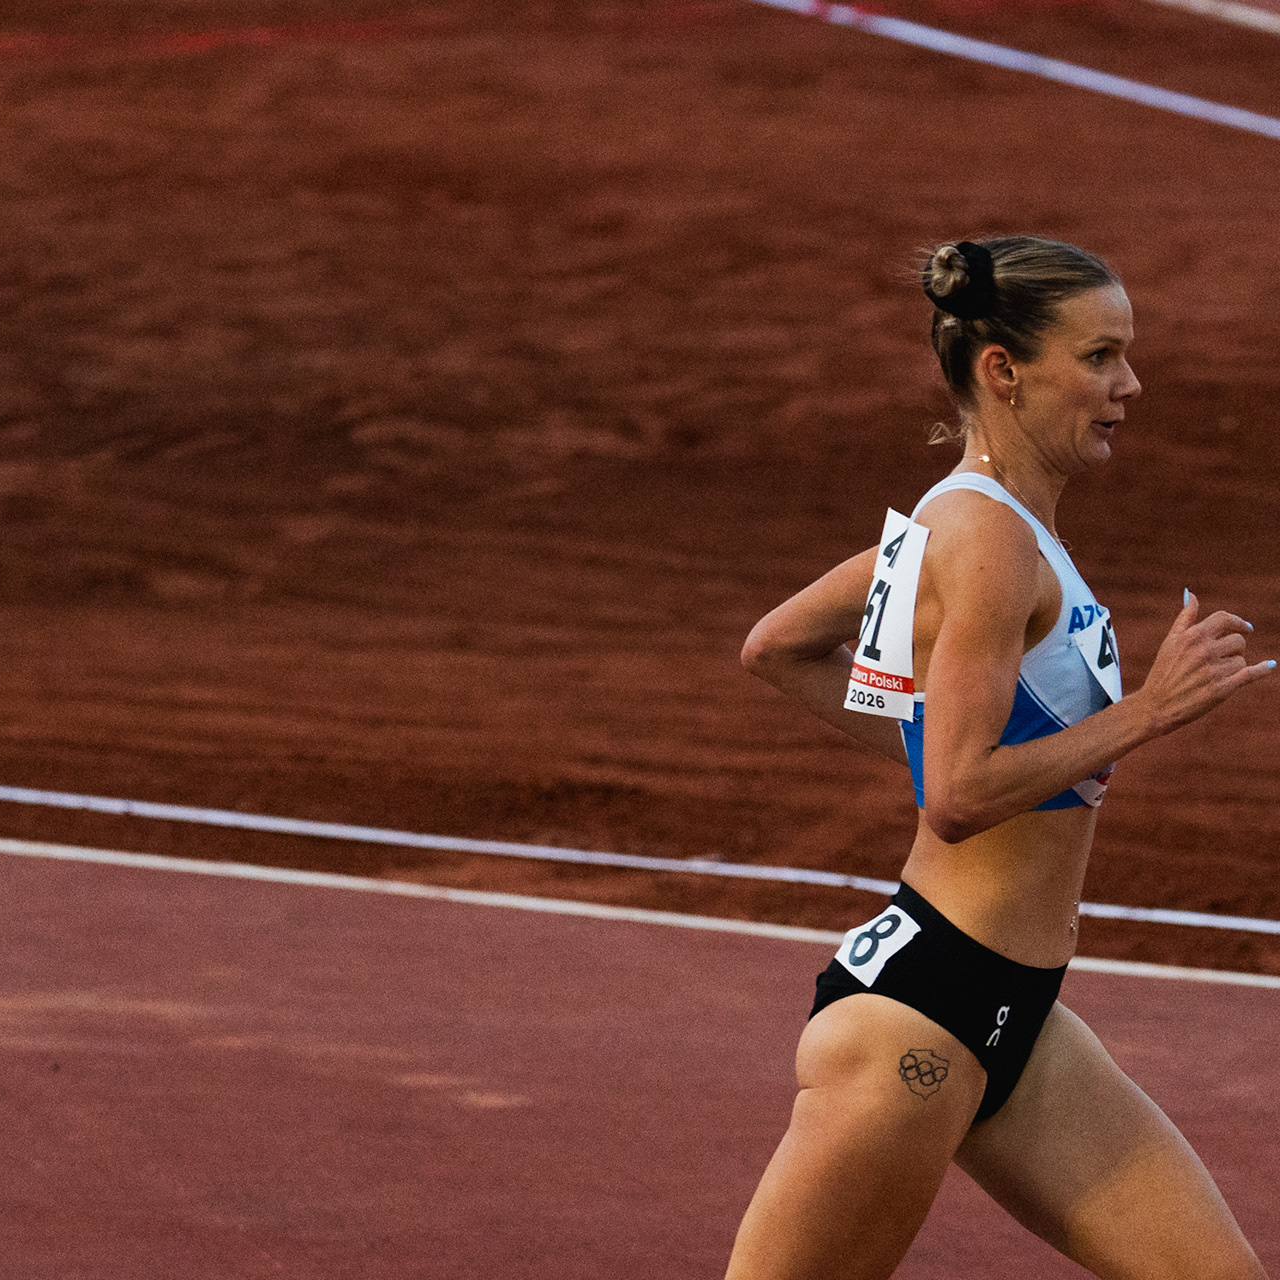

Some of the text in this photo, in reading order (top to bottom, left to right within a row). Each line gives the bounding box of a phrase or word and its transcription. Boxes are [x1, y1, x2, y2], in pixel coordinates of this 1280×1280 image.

[869, 672, 903, 691] Polski
[850, 689, 885, 709] 2026
[849, 914, 901, 966] 8
